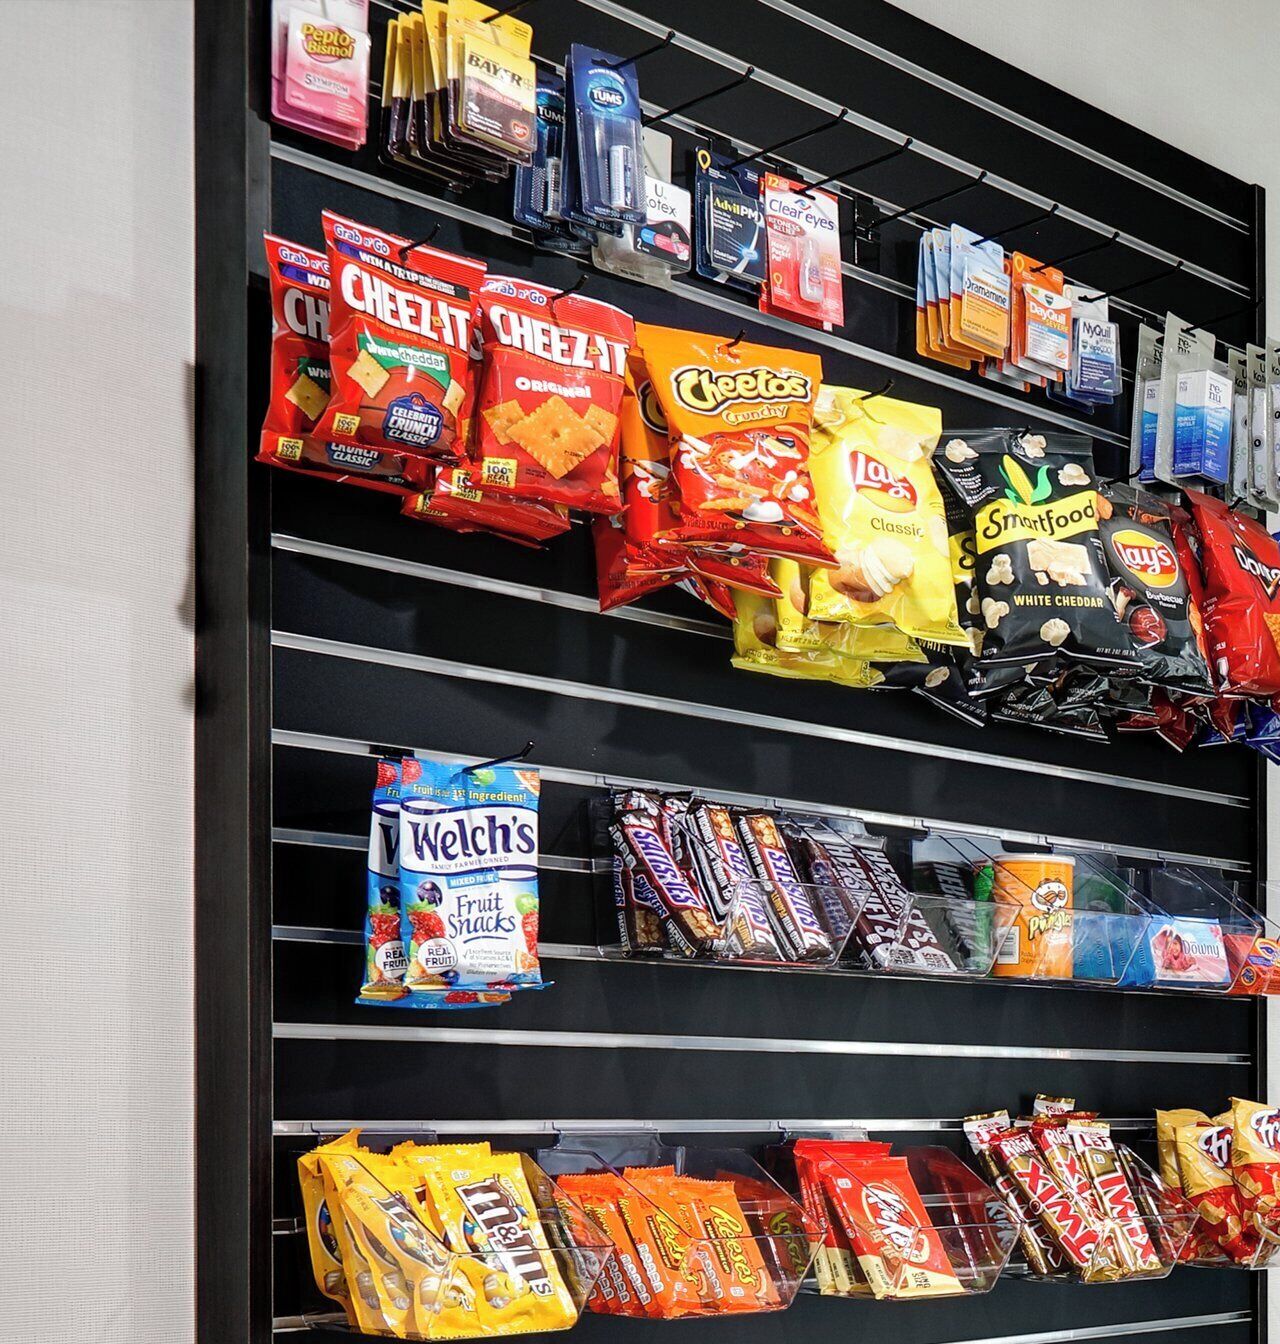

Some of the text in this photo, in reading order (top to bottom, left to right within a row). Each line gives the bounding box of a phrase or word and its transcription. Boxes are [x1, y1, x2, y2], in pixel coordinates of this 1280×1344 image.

[302, 23, 355, 48] Pepto-
[307, 42, 353, 59] Bismol
[304, 73, 312, 85] 5
[592, 90, 623, 105] TUMS
[538, 107, 566, 124] TUMS
[768, 176, 779, 188] 12
[713, 197, 740, 215] Advil
[740, 206, 760, 223] PM
[769, 198, 835, 231] Clear eyes
[334, 225, 361, 244] Grab
[374, 240, 389, 255] Go
[636, 237, 643, 250] 2
[278, 247, 309, 268] Grab
[359, 250, 384, 269] WIN
[391, 264, 419, 284] TRIP
[486, 281, 515, 297] Grab
[529, 290, 546, 305] Go
[340, 262, 472, 352] CHEEZ-IT
[1029, 301, 1067, 325] DayQuil
[1082, 320, 1112, 338] NyQuil
[489, 305, 630, 379] CHEEZ-IT
[366, 342, 446, 369] WHITE cheddar
[673, 367, 811, 412] Cheetos
[391, 405, 440, 425] CELEBRITY
[721, 404, 789, 425] Crunchy
[387, 427, 430, 446] CLASSIC
[388, 416, 438, 438] CRUNCH
[332, 452, 373, 467] CLASSIC
[486, 464, 513, 476] 100%
[486, 473, 511, 484] REAL
[870, 517, 925, 539] Classic
[982, 499, 1096, 540] Smartfood
[1120, 544, 1173, 574] Lay's
[1014, 594, 1104, 608] WHITE CHEDDAR
[1145, 589, 1185, 606] Barbecue
[413, 783, 433, 795] Fruit
[469, 791, 527, 803] Ingredient!
[406, 814, 537, 862] Welch's
[450, 876, 476, 889] MIXED
[613, 854, 626, 907] SNICKERS
[457, 892, 504, 917] Fruit
[634, 874, 670, 919] SNICKERS
[447, 911, 517, 939] Snacks
[803, 930, 831, 949] 2
[1182, 940, 1220, 959] Downy
[425, 954, 456, 967] FRUIT!
[427, 948, 450, 959] REAL
[1001, 1134, 1036, 1156] RIGH
[1016, 1159, 1100, 1266] TWIX
[1094, 1161, 1156, 1266] TWIX
[709, 1205, 758, 1288] Reese's
